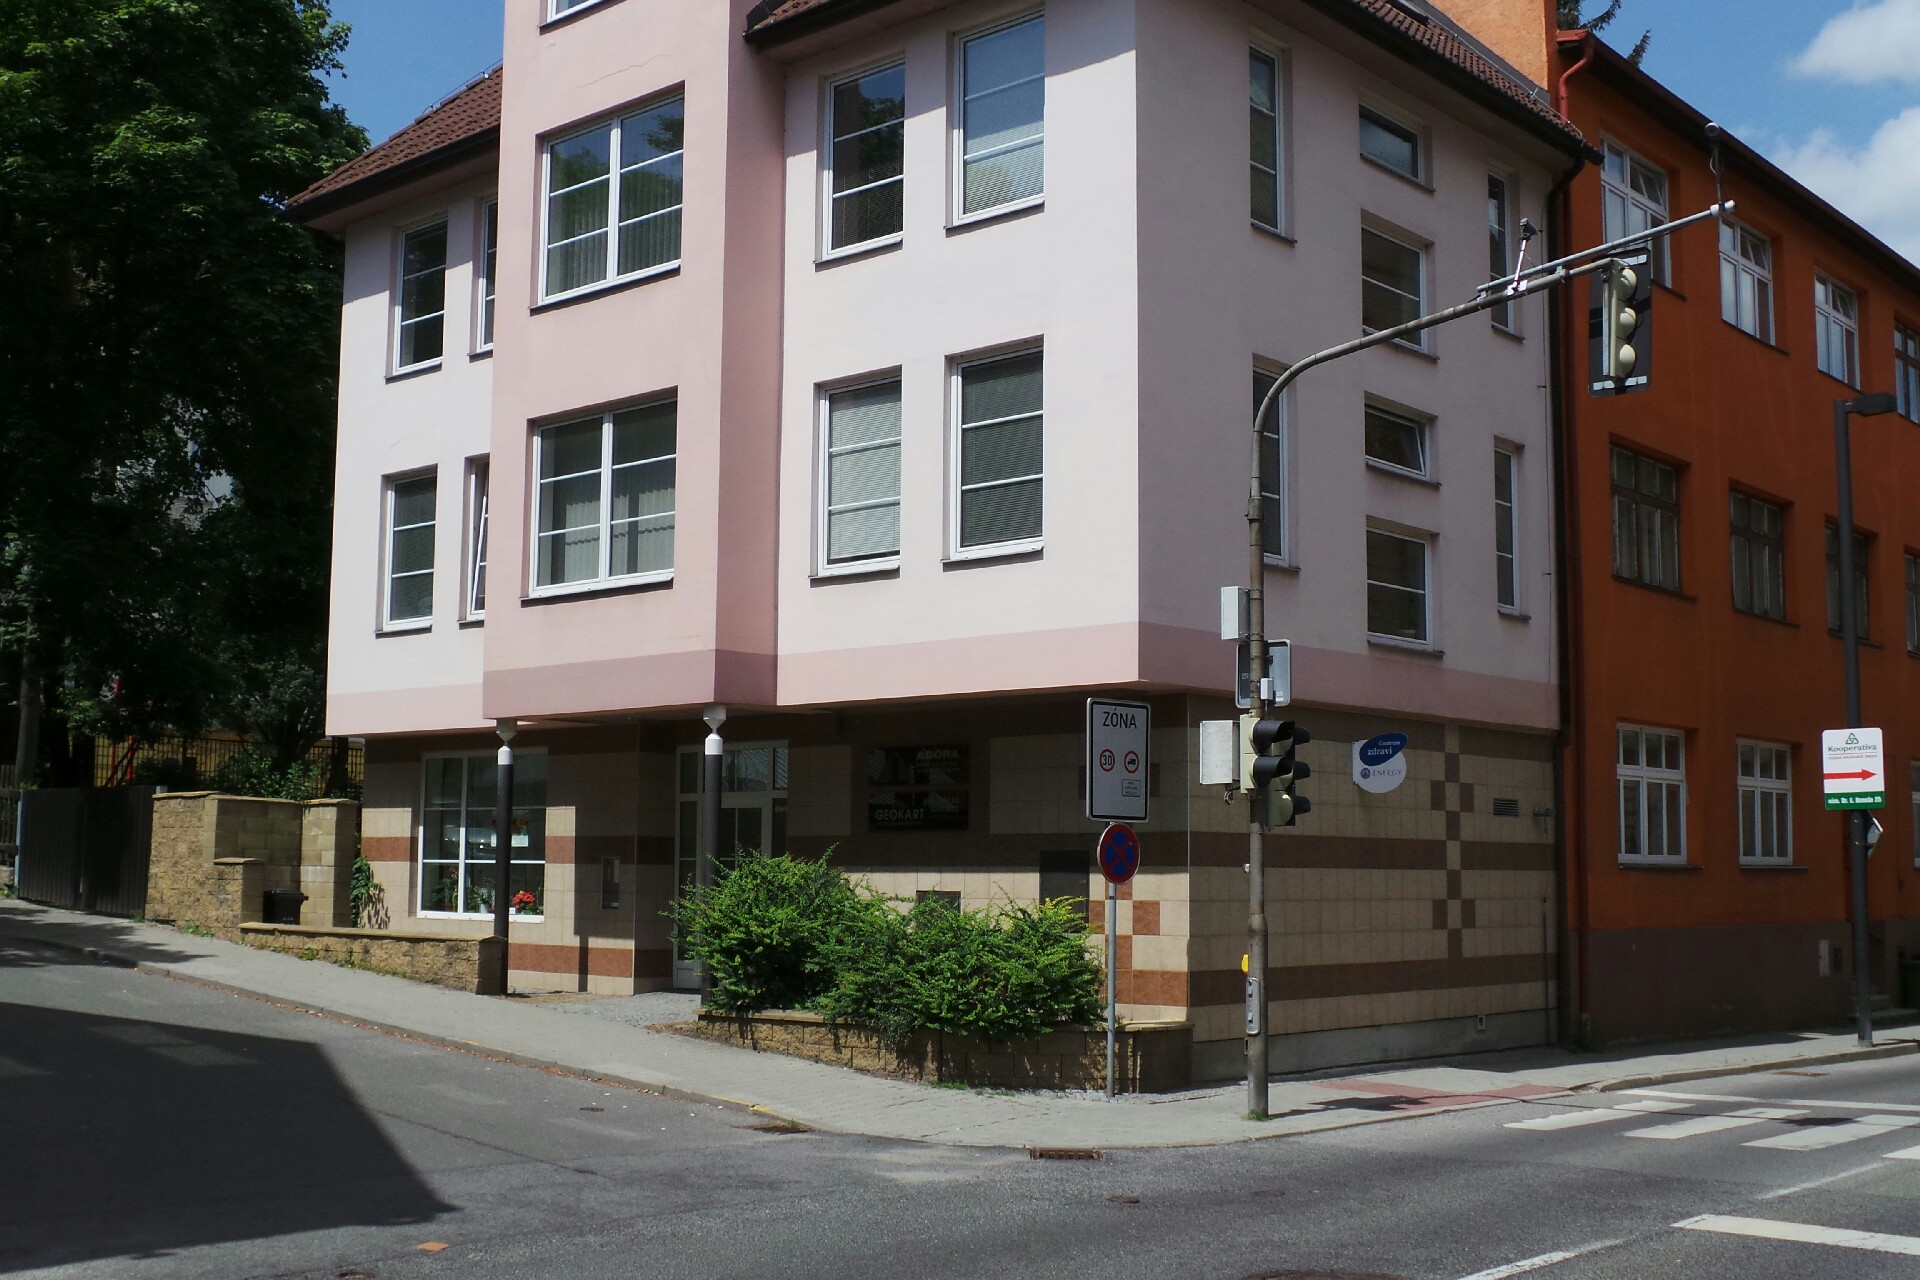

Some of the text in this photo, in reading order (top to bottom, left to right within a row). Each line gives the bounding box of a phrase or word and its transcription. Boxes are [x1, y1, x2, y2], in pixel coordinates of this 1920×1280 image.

[1102, 707, 1137, 729] ZÓNA
[1828, 743, 1877, 752] Kooperativa
[1102, 754, 1112, 766] 30
[1372, 769, 1402, 777] ENERGY
[875, 808, 925, 821] GEOKART
